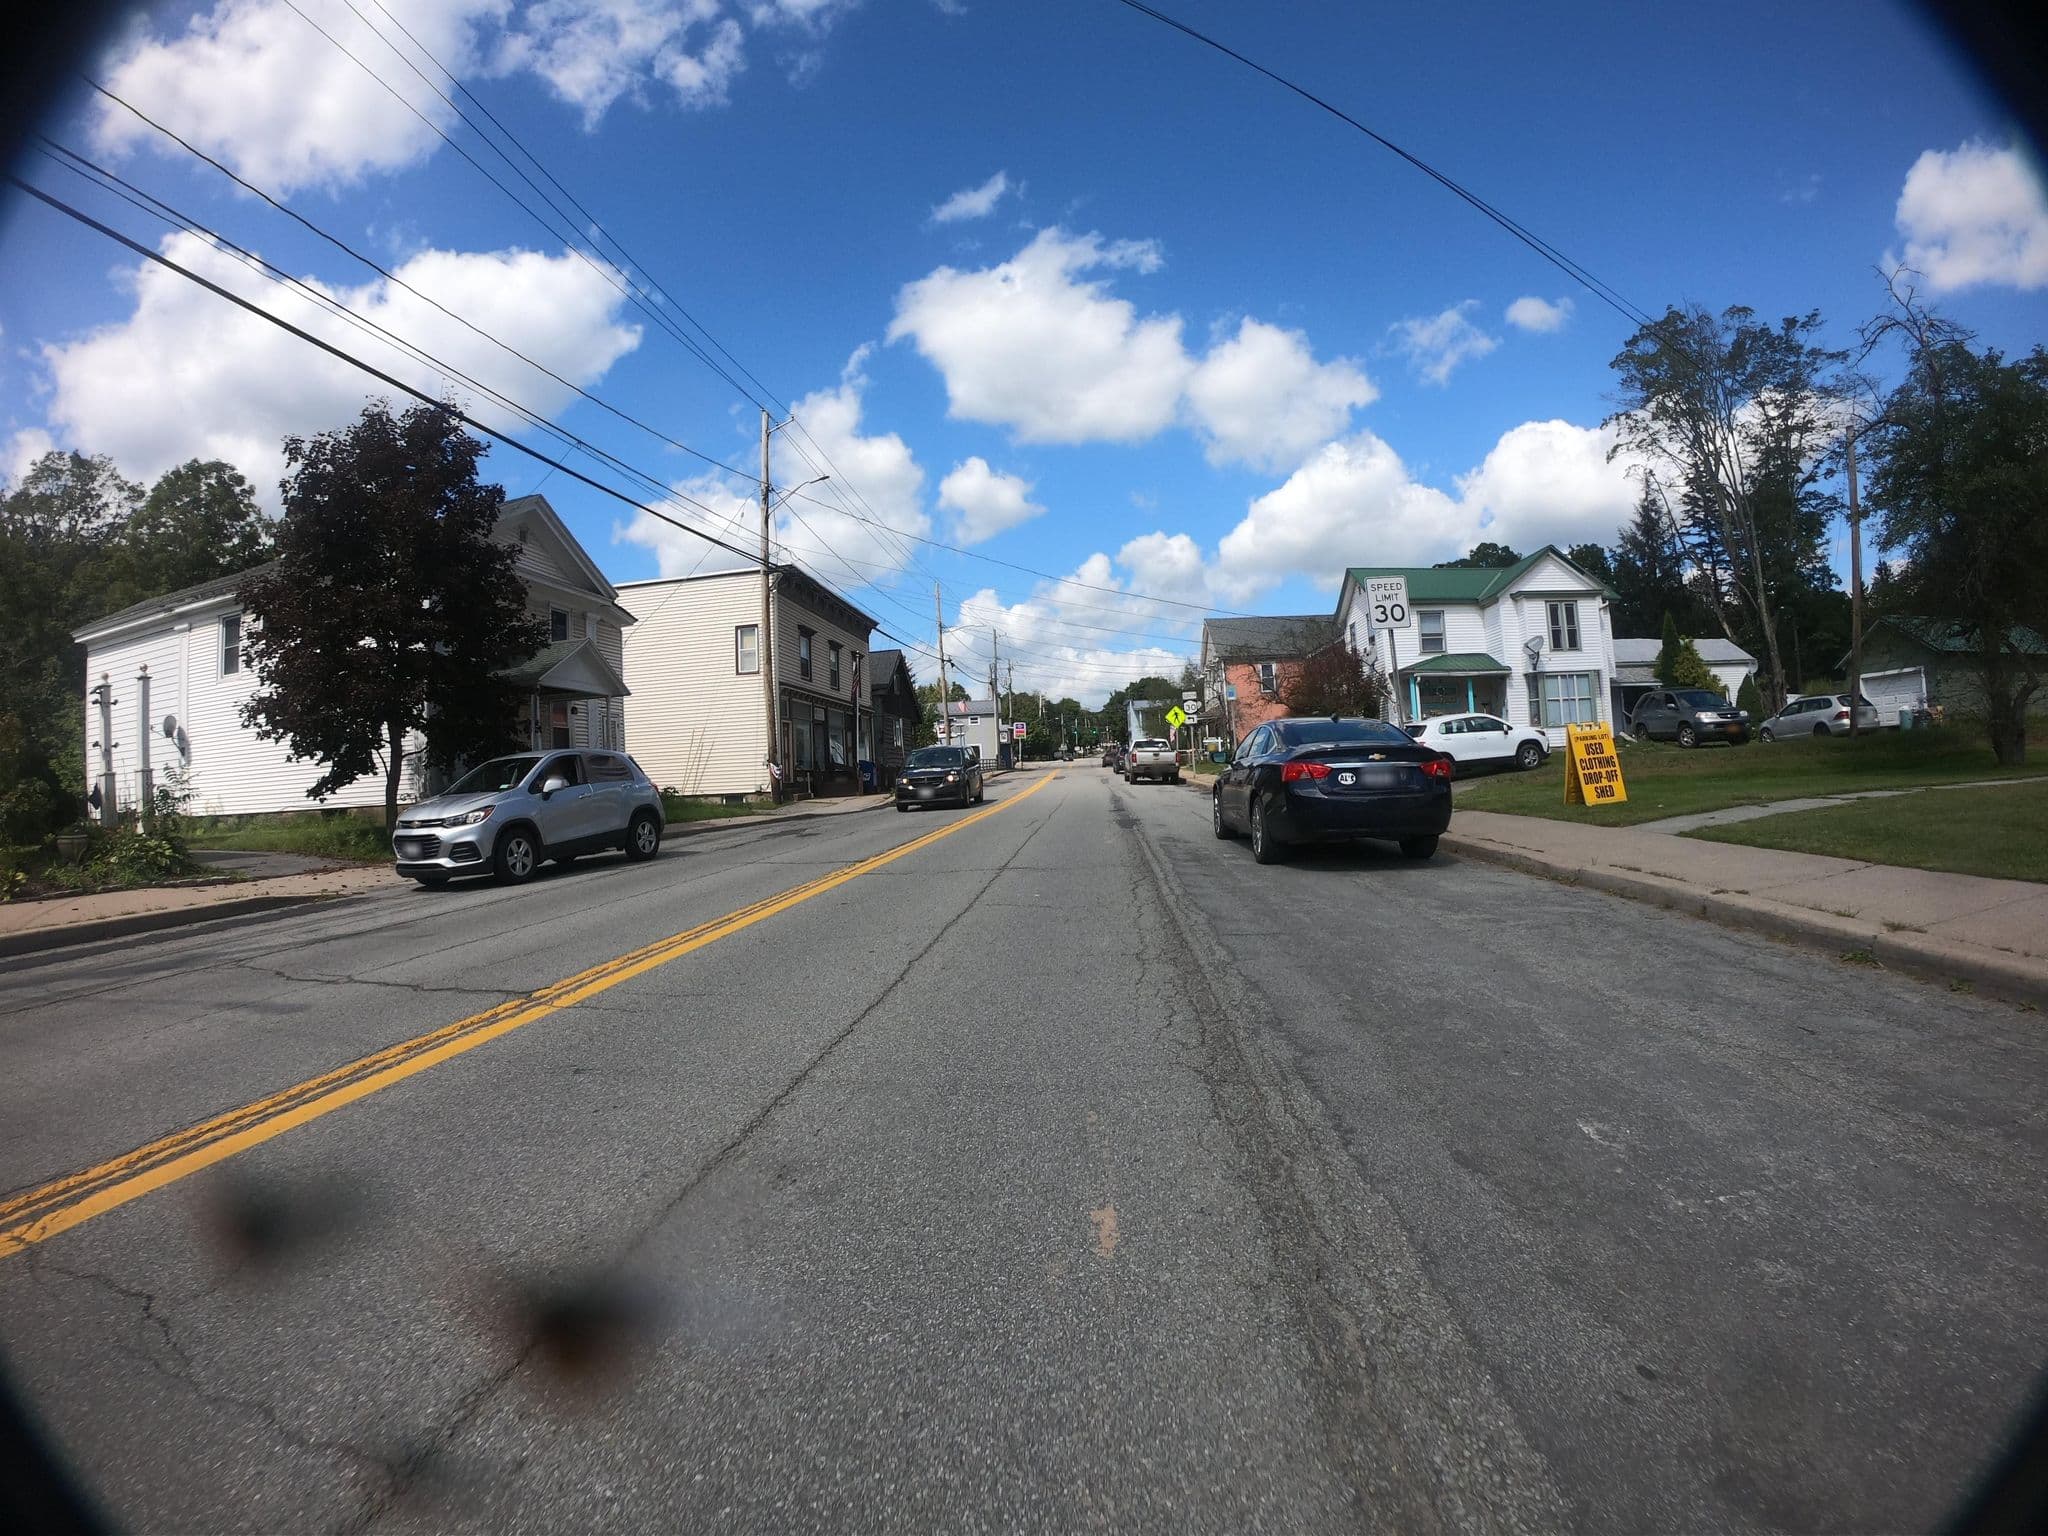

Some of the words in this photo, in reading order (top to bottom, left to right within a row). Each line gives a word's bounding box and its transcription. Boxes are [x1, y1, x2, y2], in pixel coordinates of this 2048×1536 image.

[1370, 582, 1403, 592] SPEED
[1375, 593, 1400, 602] LIMIT
[1374, 603, 1405, 623] 30
[1584, 742, 1605, 755] USED
[1579, 755, 1616, 771] CLOTHING
[1583, 769, 1619, 785] DROP-OFF
[1594, 784, 1615, 799] SHED
